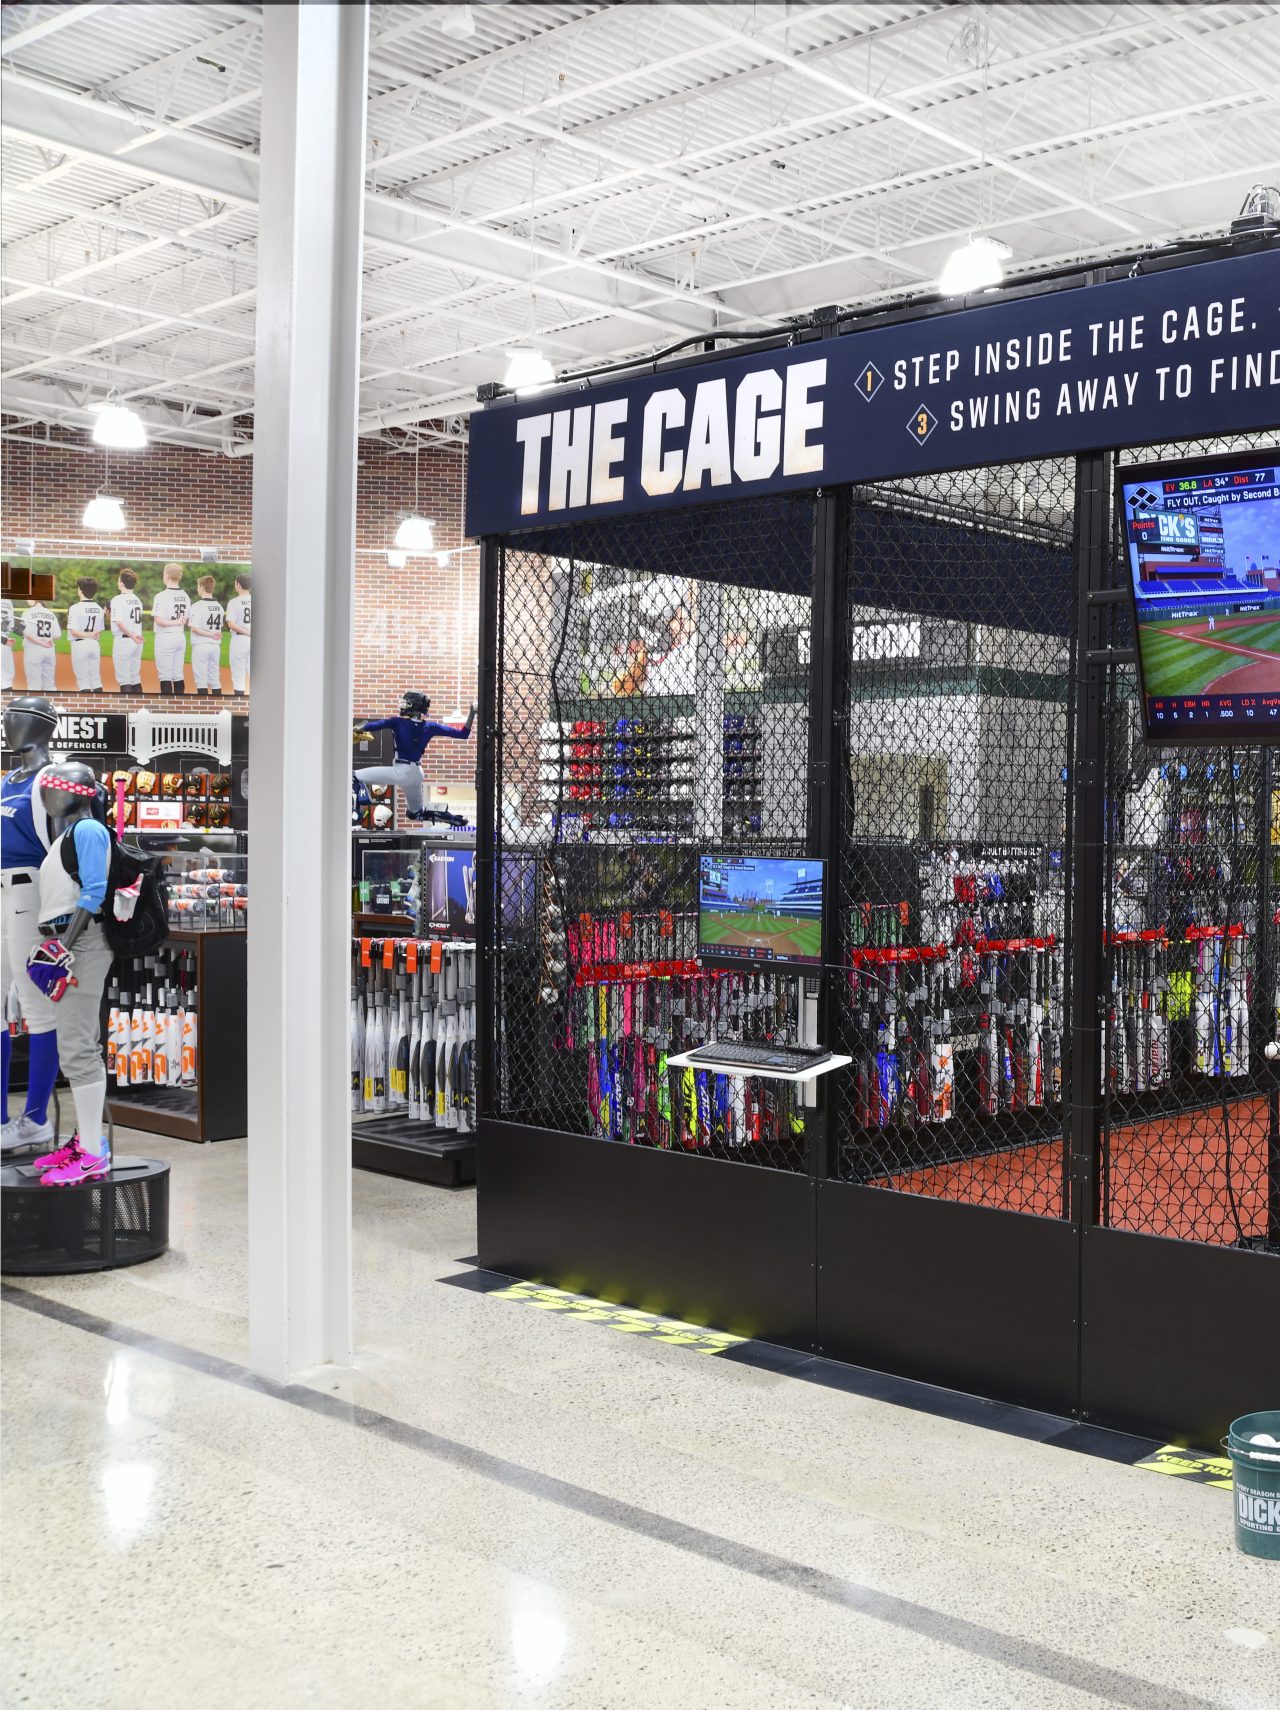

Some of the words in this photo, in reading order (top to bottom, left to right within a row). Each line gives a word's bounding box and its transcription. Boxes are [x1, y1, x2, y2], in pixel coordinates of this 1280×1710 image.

[865, 370, 874, 392] 1
[893, 350, 959, 391] STEP
[973, 328, 1073, 376] INSIDE
[1089, 315, 1145, 357] THE
[1162, 296, 1257, 345] CAGE.
[916, 413, 928, 436] 3
[950, 385, 1041, 433] SWING
[1056, 368, 1141, 418] AWAY
[1156, 363, 1193, 401] TO
[515, 397, 628, 516] THE
[640, 358, 828, 497] CAGE
[1165, 484, 1175, 493] EV
[1179, 481, 1197, 491] 36.8
[1203, 479, 1213, 488] LA
[1233, 475, 1249, 485] Dist
[1255, 473, 1266, 482] 77
[1167, 497, 1181, 508] FLY
[1183, 494, 1201, 507] OUT,
[1202, 491, 1229, 505] Caught
[1232, 490, 1241, 502] by
[1243, 488, 1271, 499] Second
[1132, 522, 1155, 530] Points
[206, 613, 221, 630] 44
[1171, 610, 1199, 619] HitTrax
[36, 619, 52, 638] 83
[1201, 700, 1210, 708] HR
[1219, 699, 1232, 707] AVG
[1246, 709, 1254, 717] 10
[1269, 708, 1278, 716] 47
[56, 741, 108, 749] DEFENDERS
[1156, 1453, 1204, 1469] KEEP
[1250, 1488, 1276, 1499] SEASON
[1239, 1517, 1274, 1533] SPORTING
